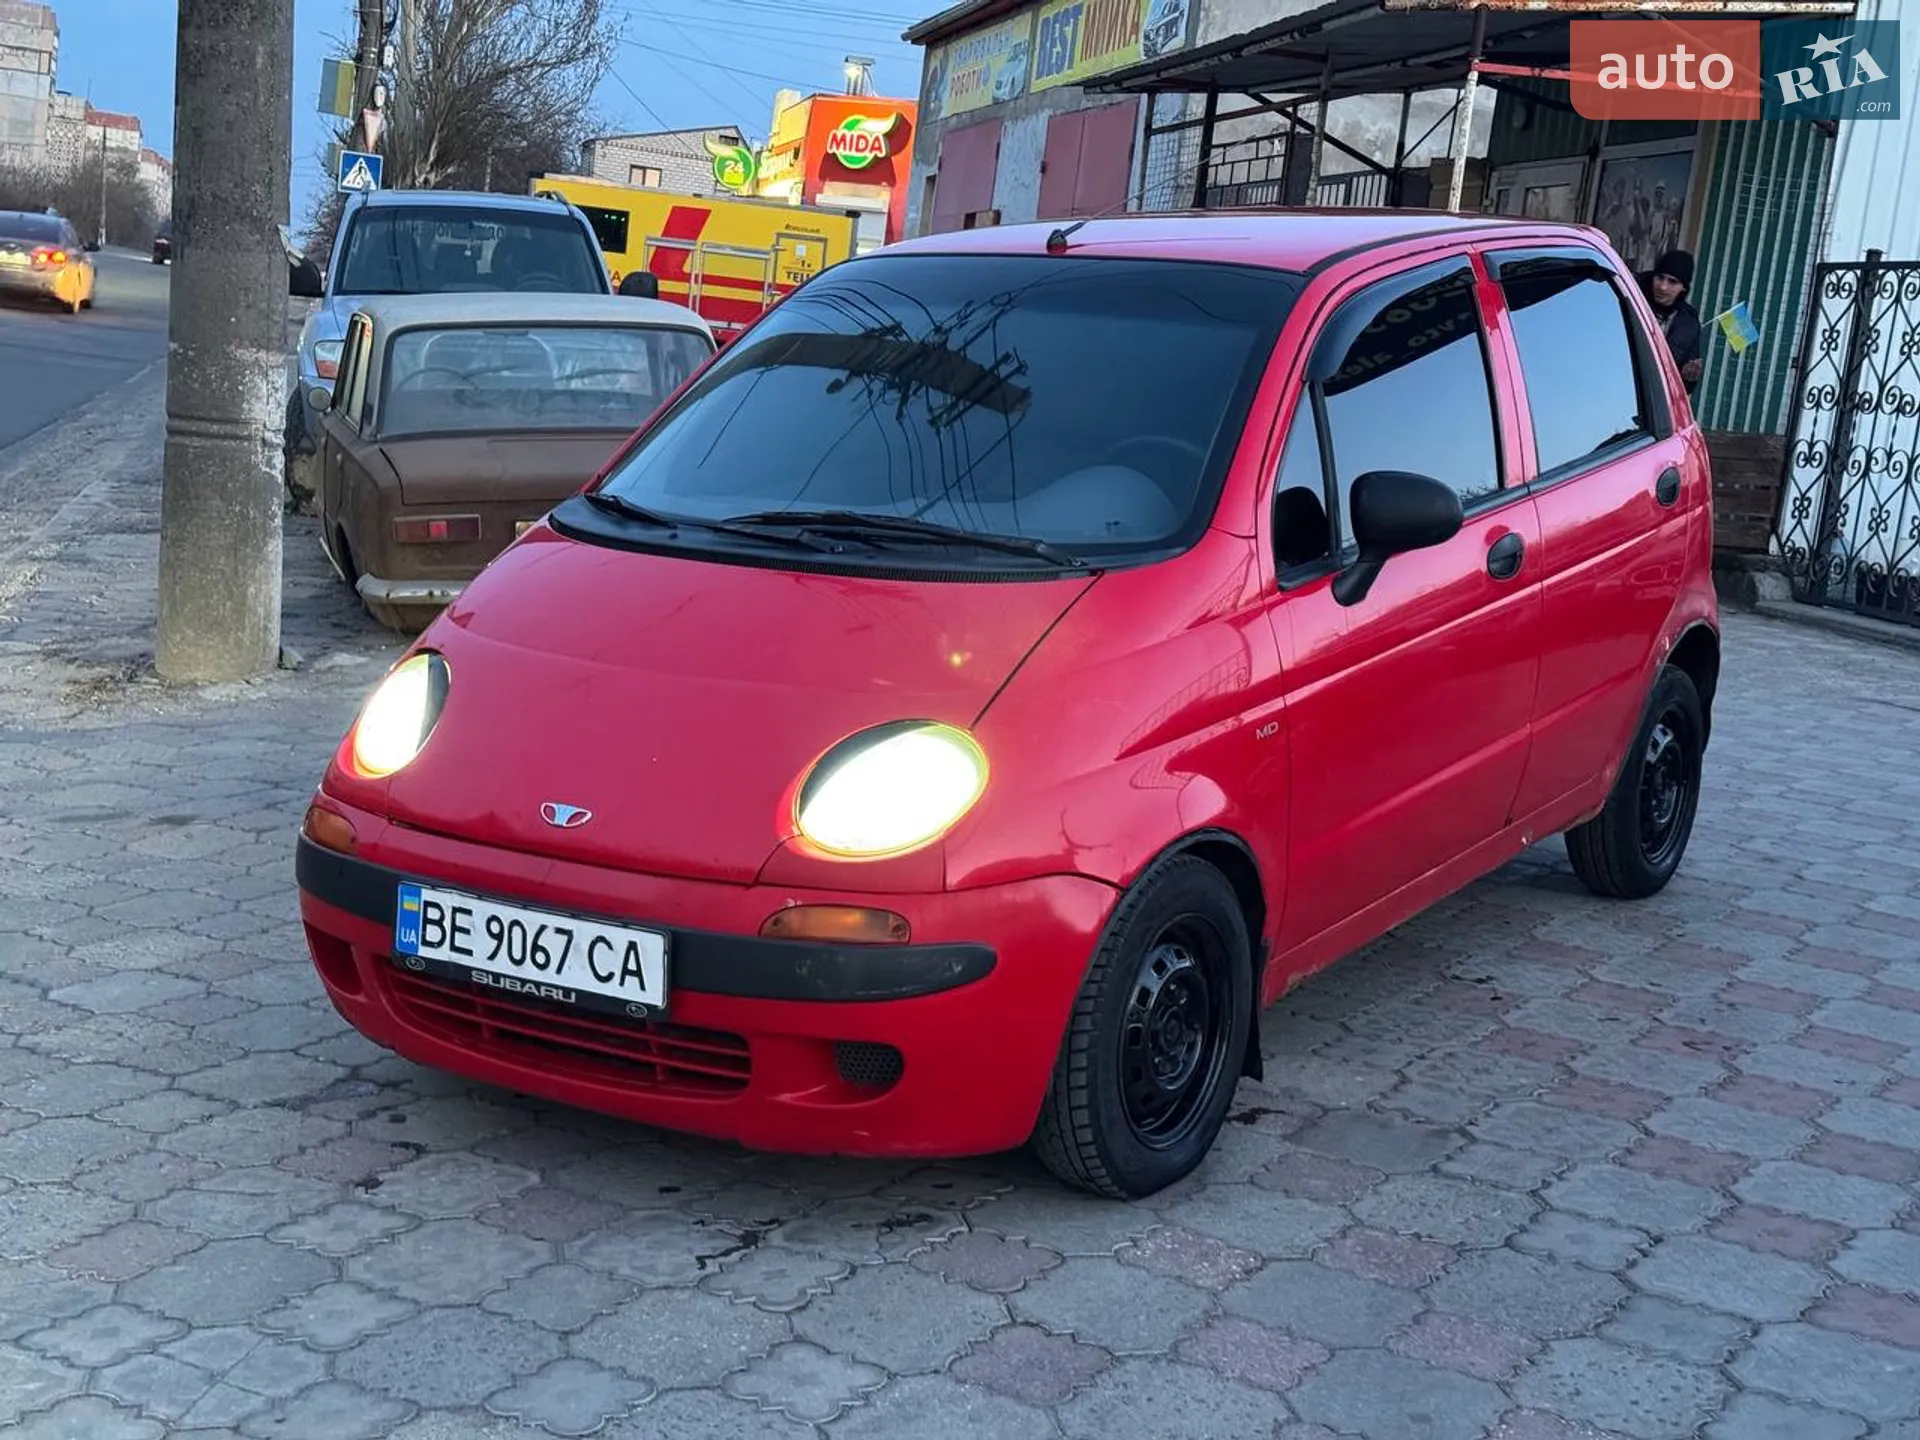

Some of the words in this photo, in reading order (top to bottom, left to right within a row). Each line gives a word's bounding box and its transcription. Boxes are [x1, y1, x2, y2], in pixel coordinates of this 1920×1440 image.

[1036, 3, 1084, 80] BEST
[828, 131, 884, 156] MIDA
[401, 927, 417, 946] UA
[420, 900, 474, 957] BE
[486, 914, 574, 975] 9067
[587, 935, 647, 992] CA
[471, 970, 576, 1003] SUBARU
